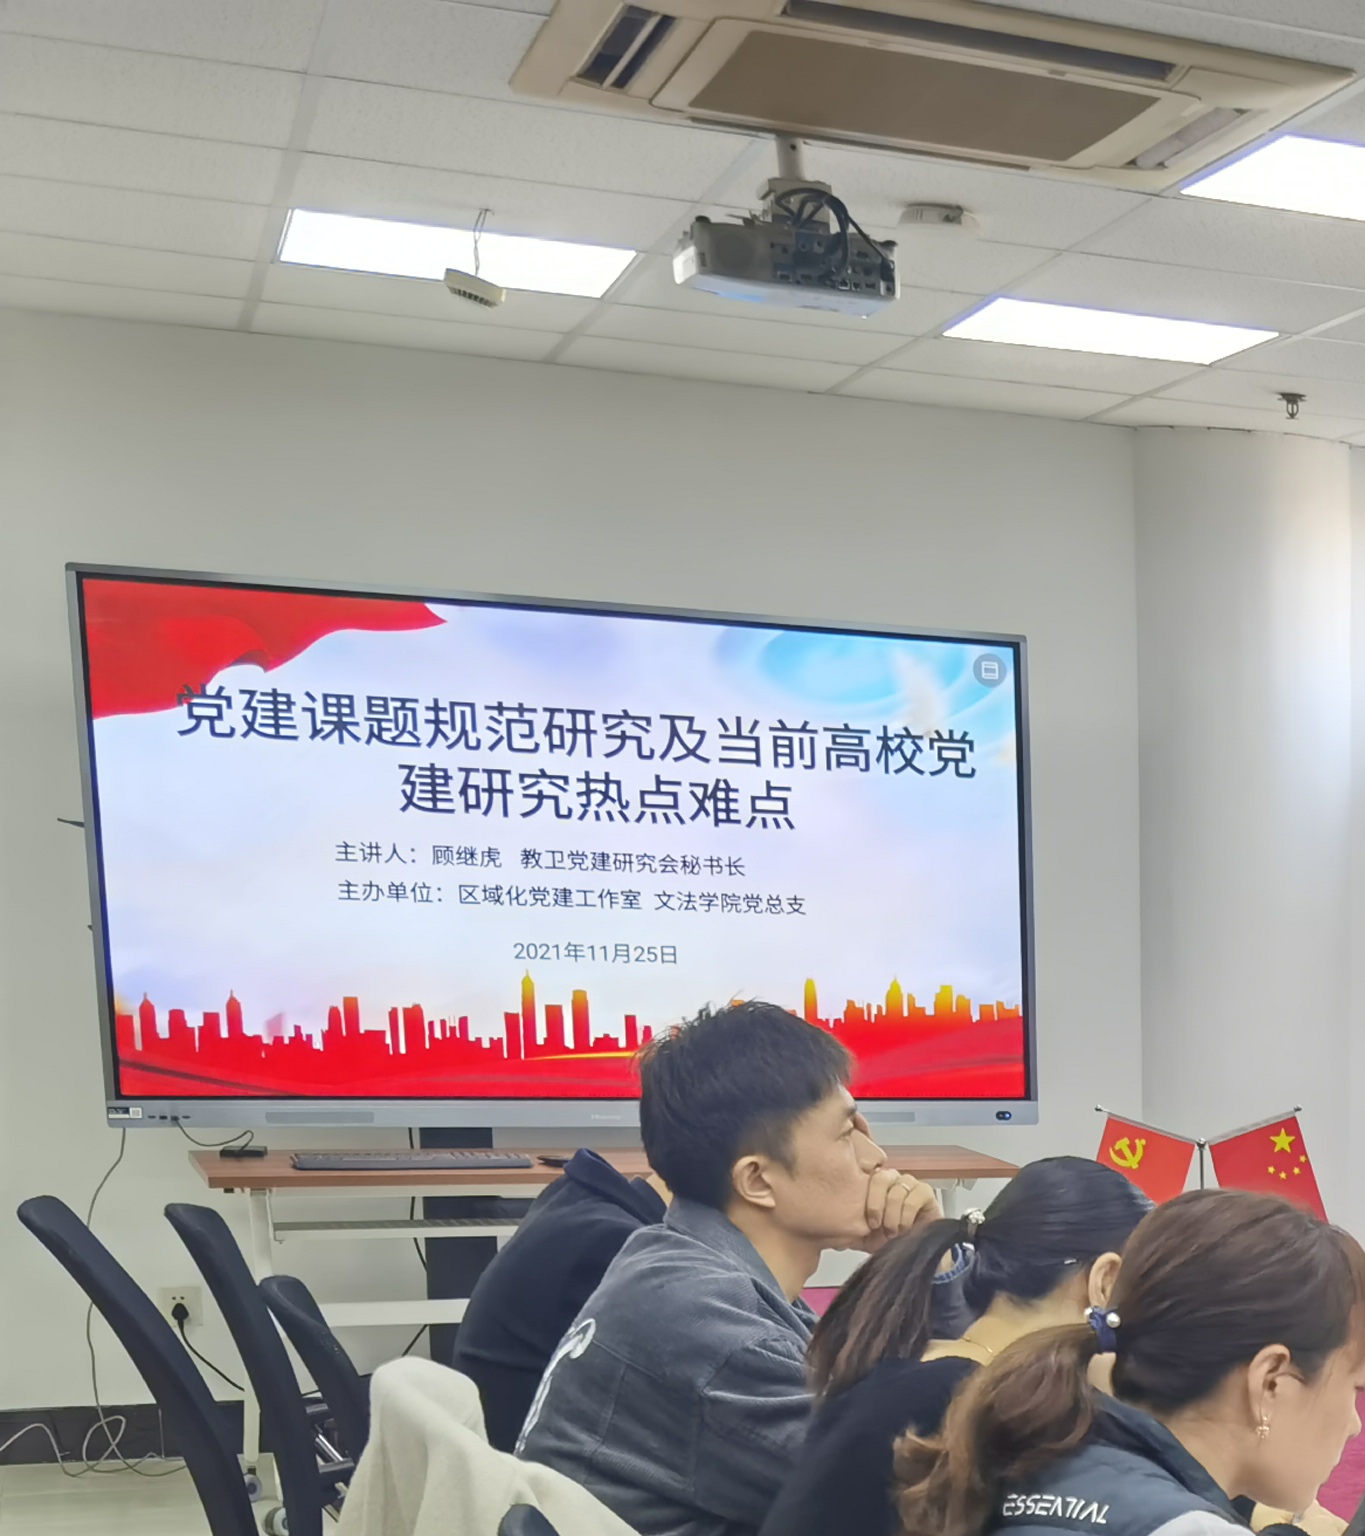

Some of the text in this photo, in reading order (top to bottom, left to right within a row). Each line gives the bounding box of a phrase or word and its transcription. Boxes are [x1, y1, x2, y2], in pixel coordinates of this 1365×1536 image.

[177, 683, 977, 780] 党建课题规范研究及当前高校党
[398, 763, 797, 831] 建研究热点难点
[520, 847, 747, 878] 教卫党建研究会秘书长
[653, 890, 807, 917] 文法学院党总支
[513, 941, 679, 967] 2021年11月25日
[1002, 1493, 1110, 1525] ESSENTIAL
